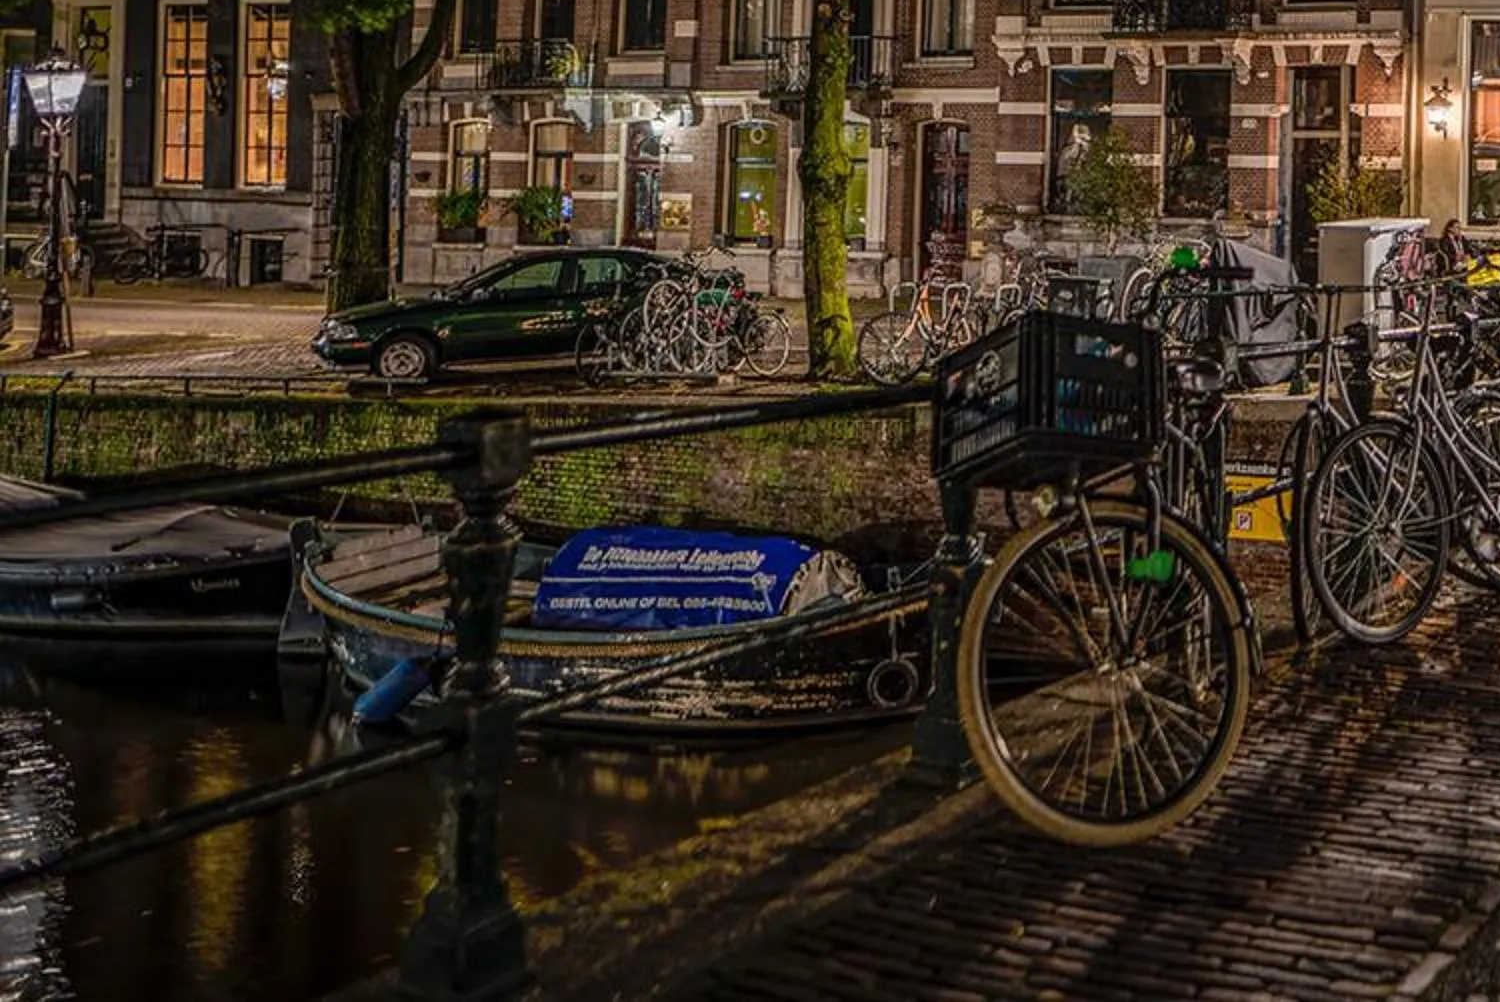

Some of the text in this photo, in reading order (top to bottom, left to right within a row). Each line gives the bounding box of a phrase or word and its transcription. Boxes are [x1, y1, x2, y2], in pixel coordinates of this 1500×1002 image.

[594, 597, 638, 610] ONLINE
[639, 597, 657, 609] OF
[657, 597, 681, 610] BEL
